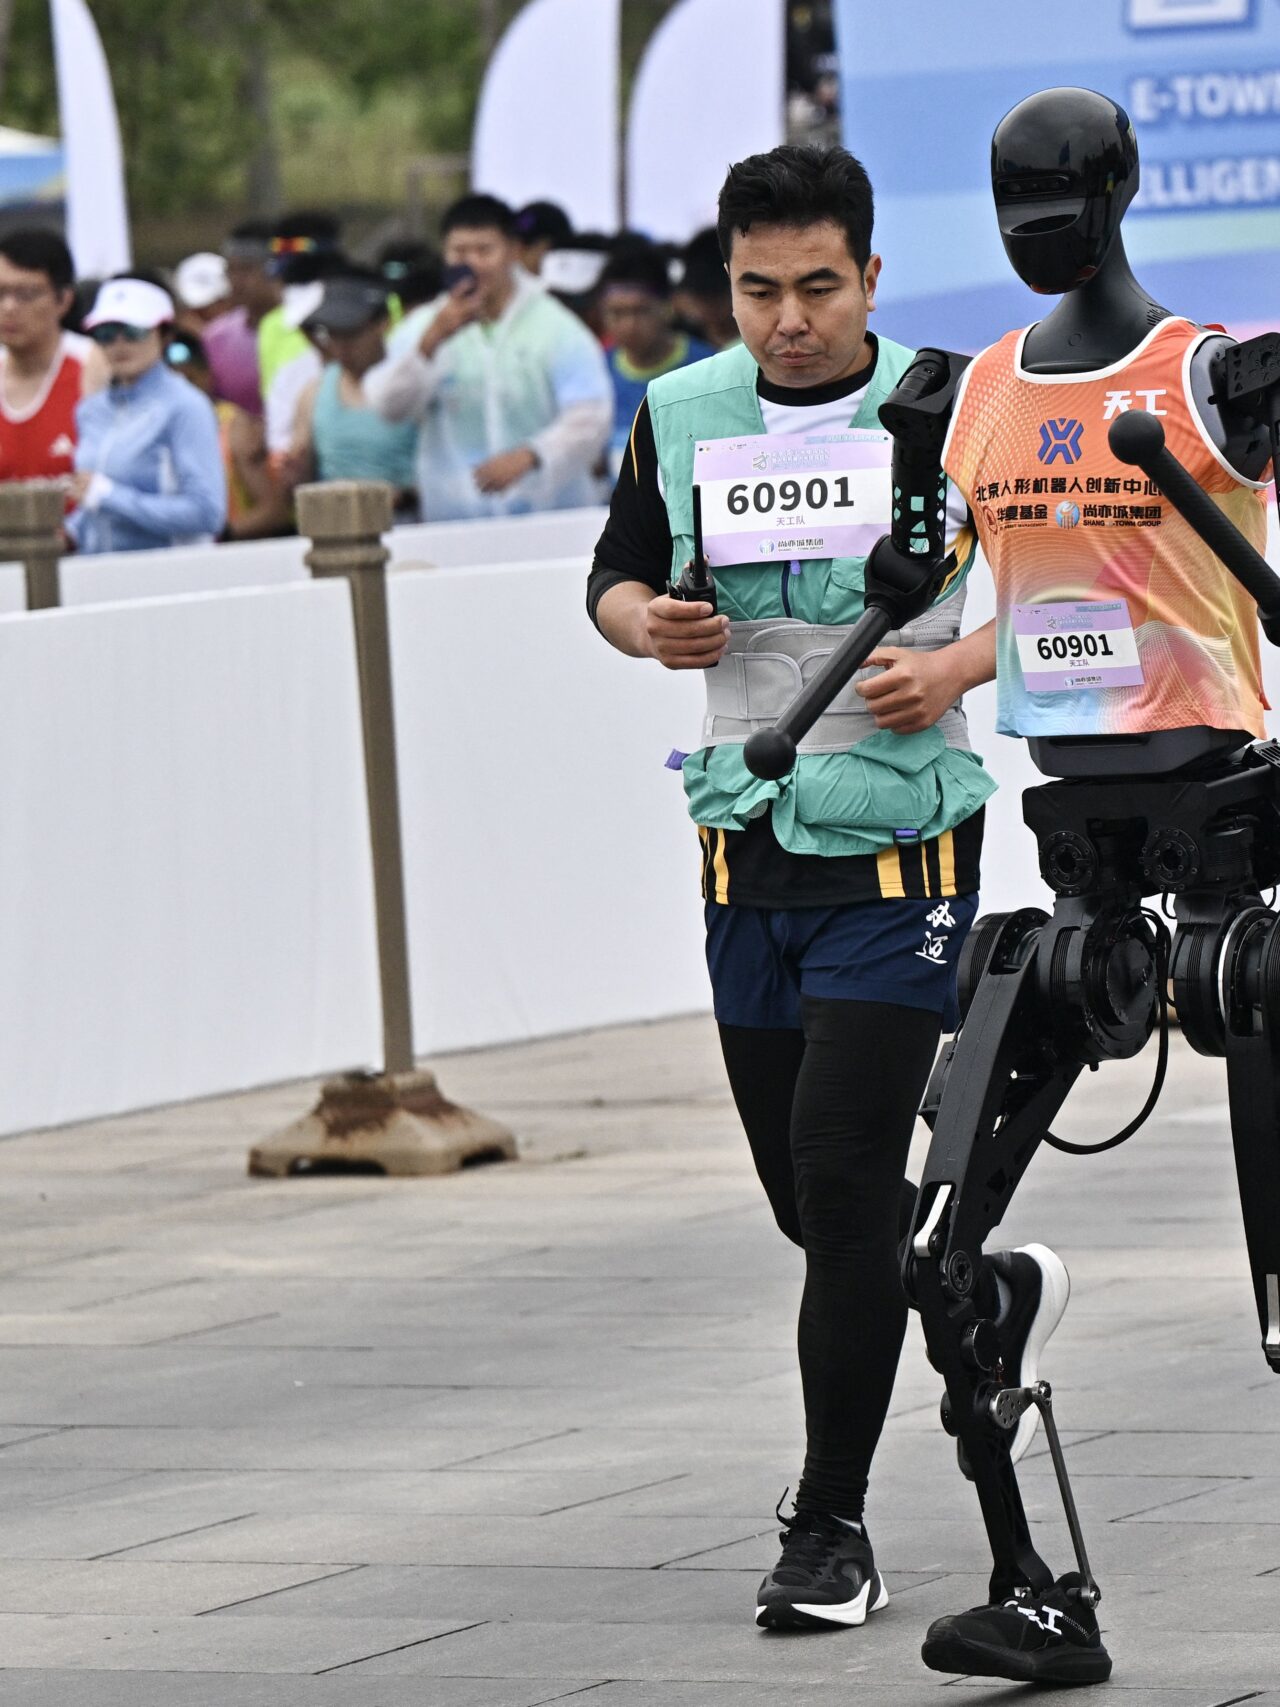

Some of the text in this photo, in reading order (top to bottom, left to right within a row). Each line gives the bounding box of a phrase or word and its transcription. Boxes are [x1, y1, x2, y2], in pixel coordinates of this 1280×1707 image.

[1103, 389, 1167, 420] 天工
[726, 476, 854, 515] 60901
[976, 477, 1163, 502] 北京人形机器人创新中心
[776, 515, 806, 526] 天工队
[1083, 504, 1161, 519] 尚亦城集团
[1037, 634, 1113, 660] 60901
